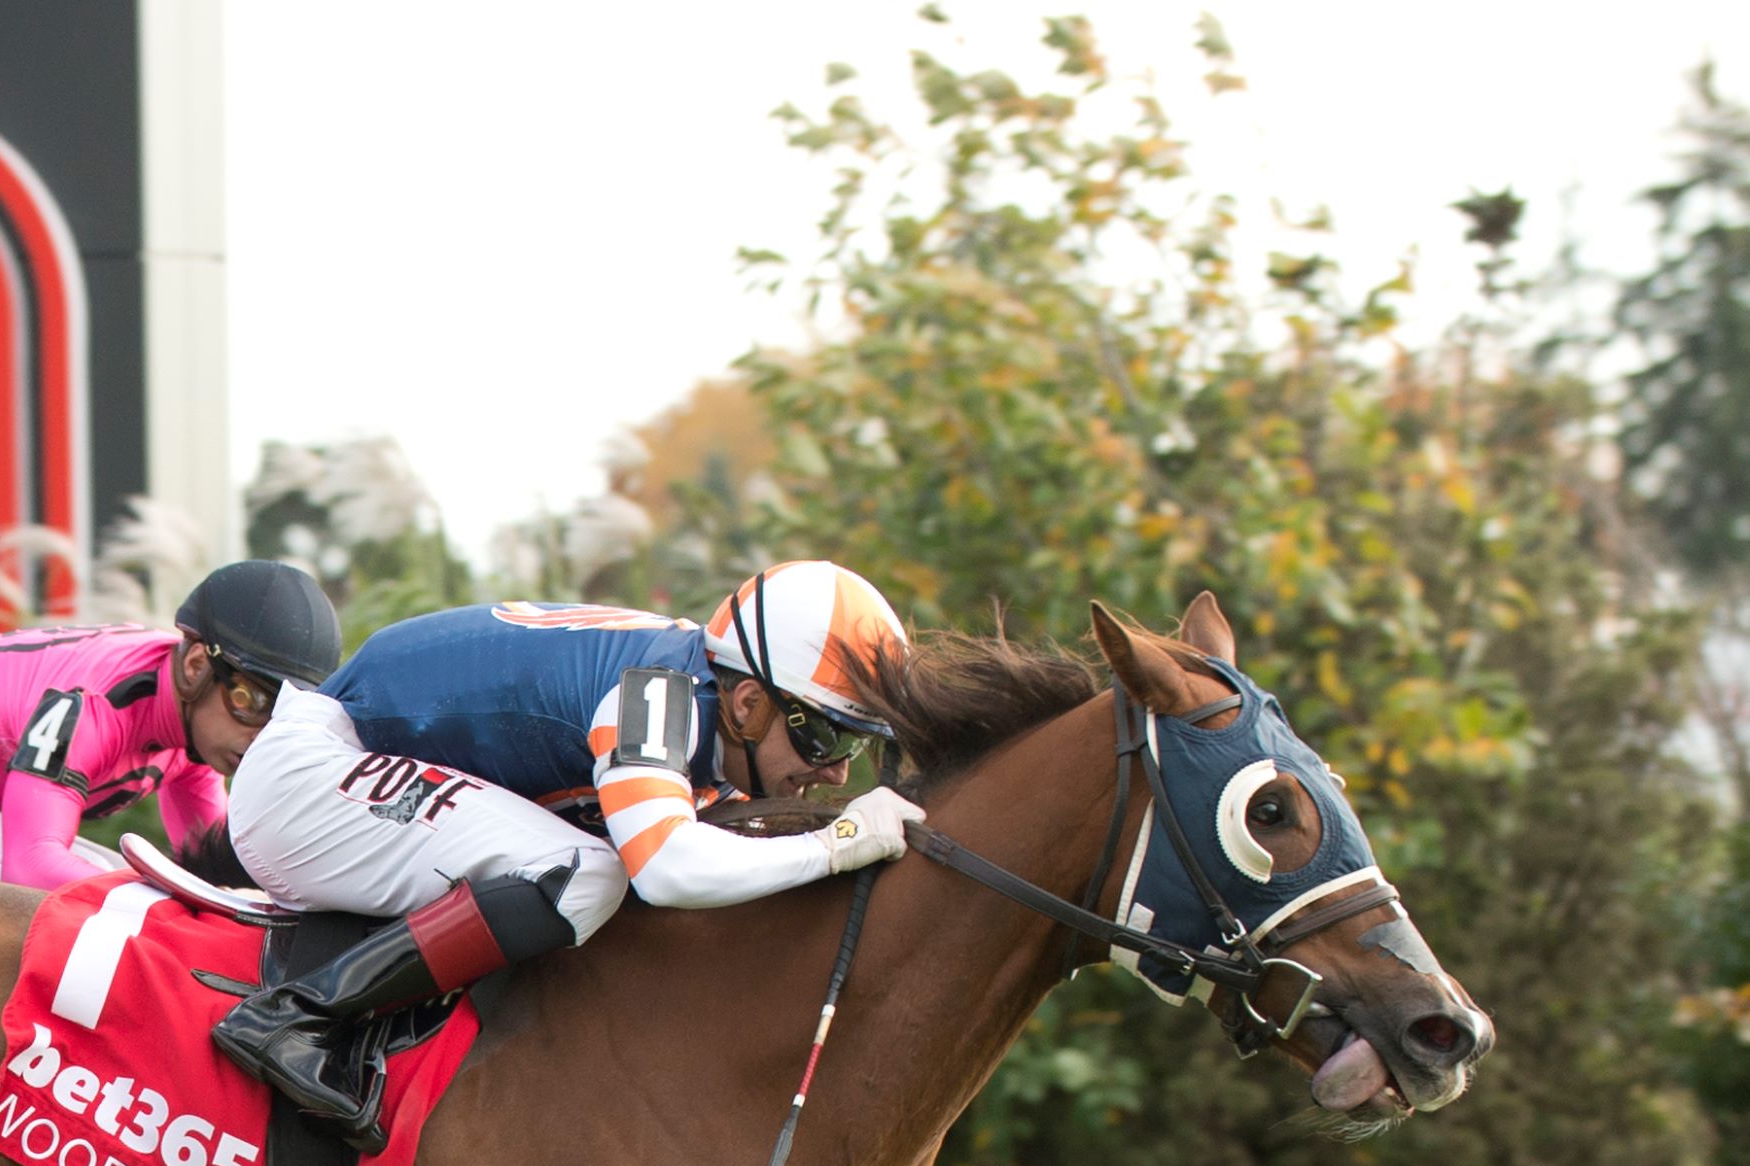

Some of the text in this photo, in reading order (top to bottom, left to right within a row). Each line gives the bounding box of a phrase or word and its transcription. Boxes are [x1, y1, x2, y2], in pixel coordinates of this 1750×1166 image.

[26, 697, 72, 771] 4
[639, 676, 669, 760] 1
[51, 881, 174, 1030] 1
